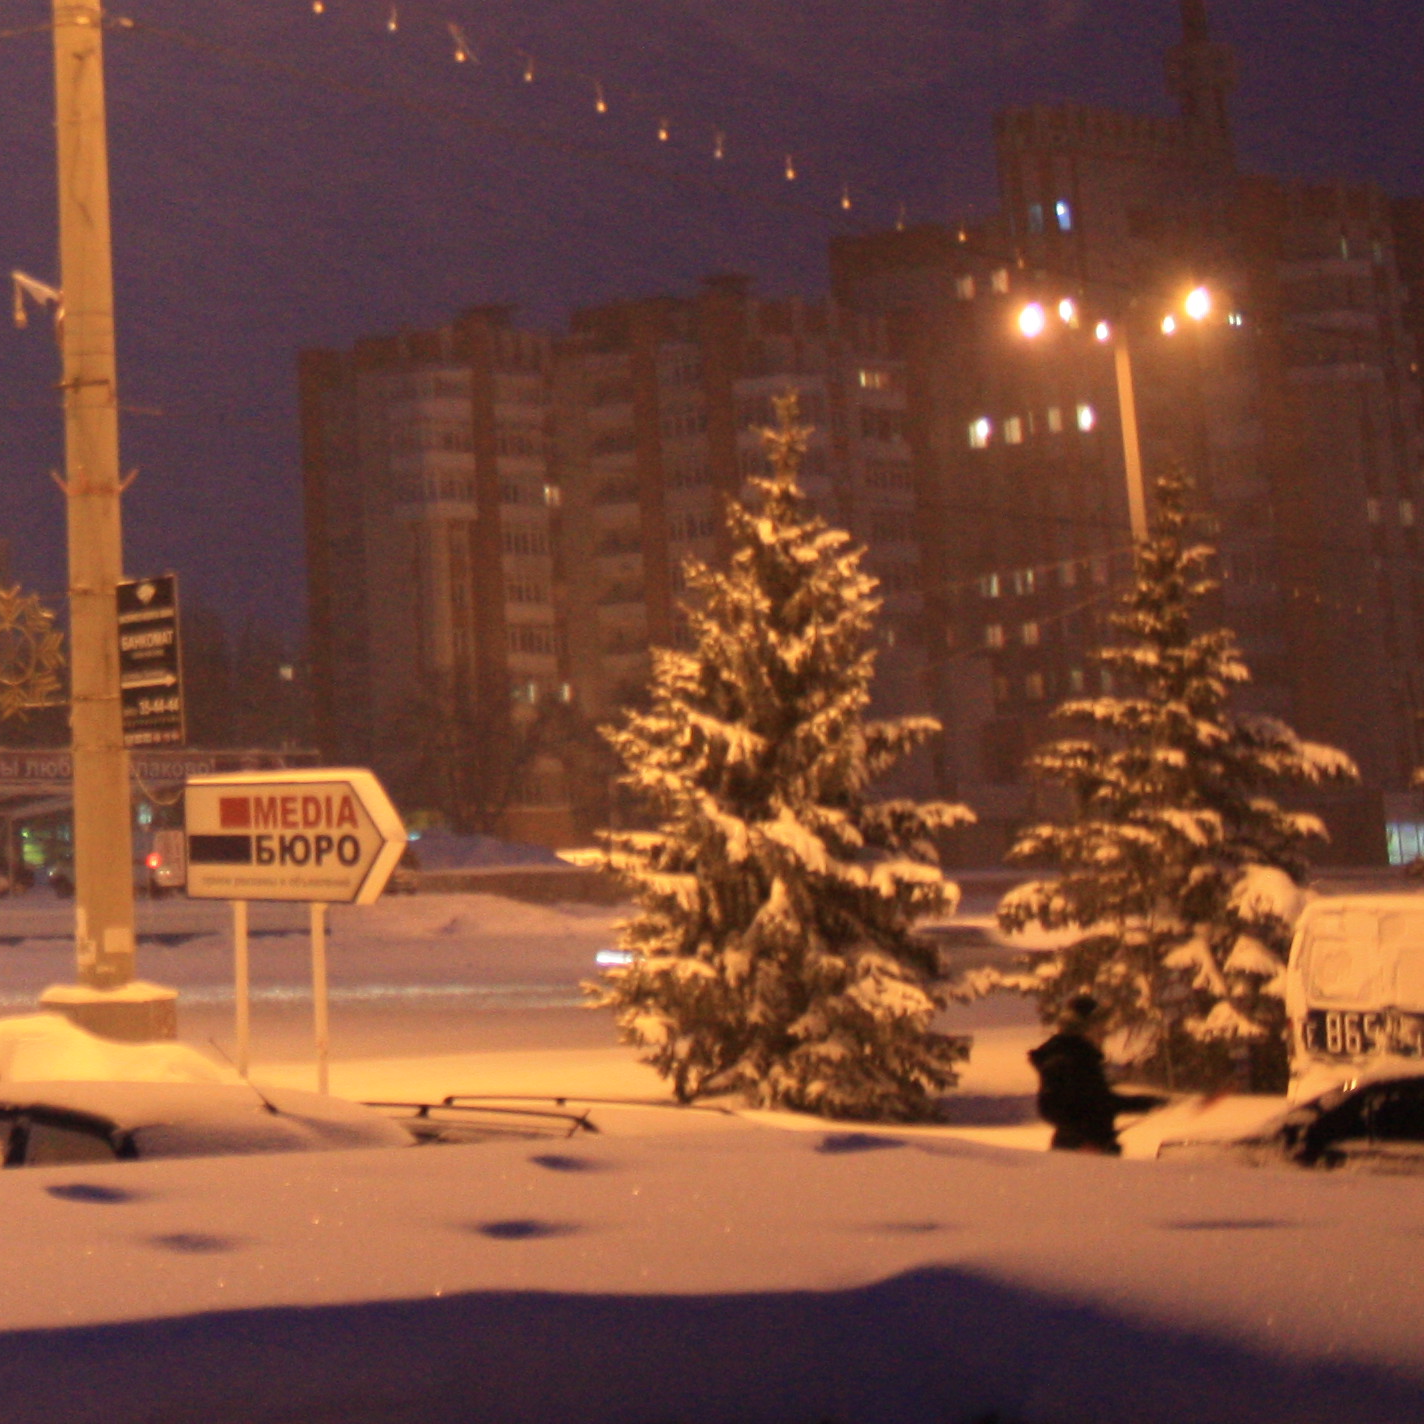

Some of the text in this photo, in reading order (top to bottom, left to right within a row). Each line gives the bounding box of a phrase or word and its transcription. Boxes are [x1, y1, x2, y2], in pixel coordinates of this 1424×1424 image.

[25, 755, 71, 777] люб
[253, 795, 359, 829] MEDIA
[255, 834, 361, 868] БЮРО
